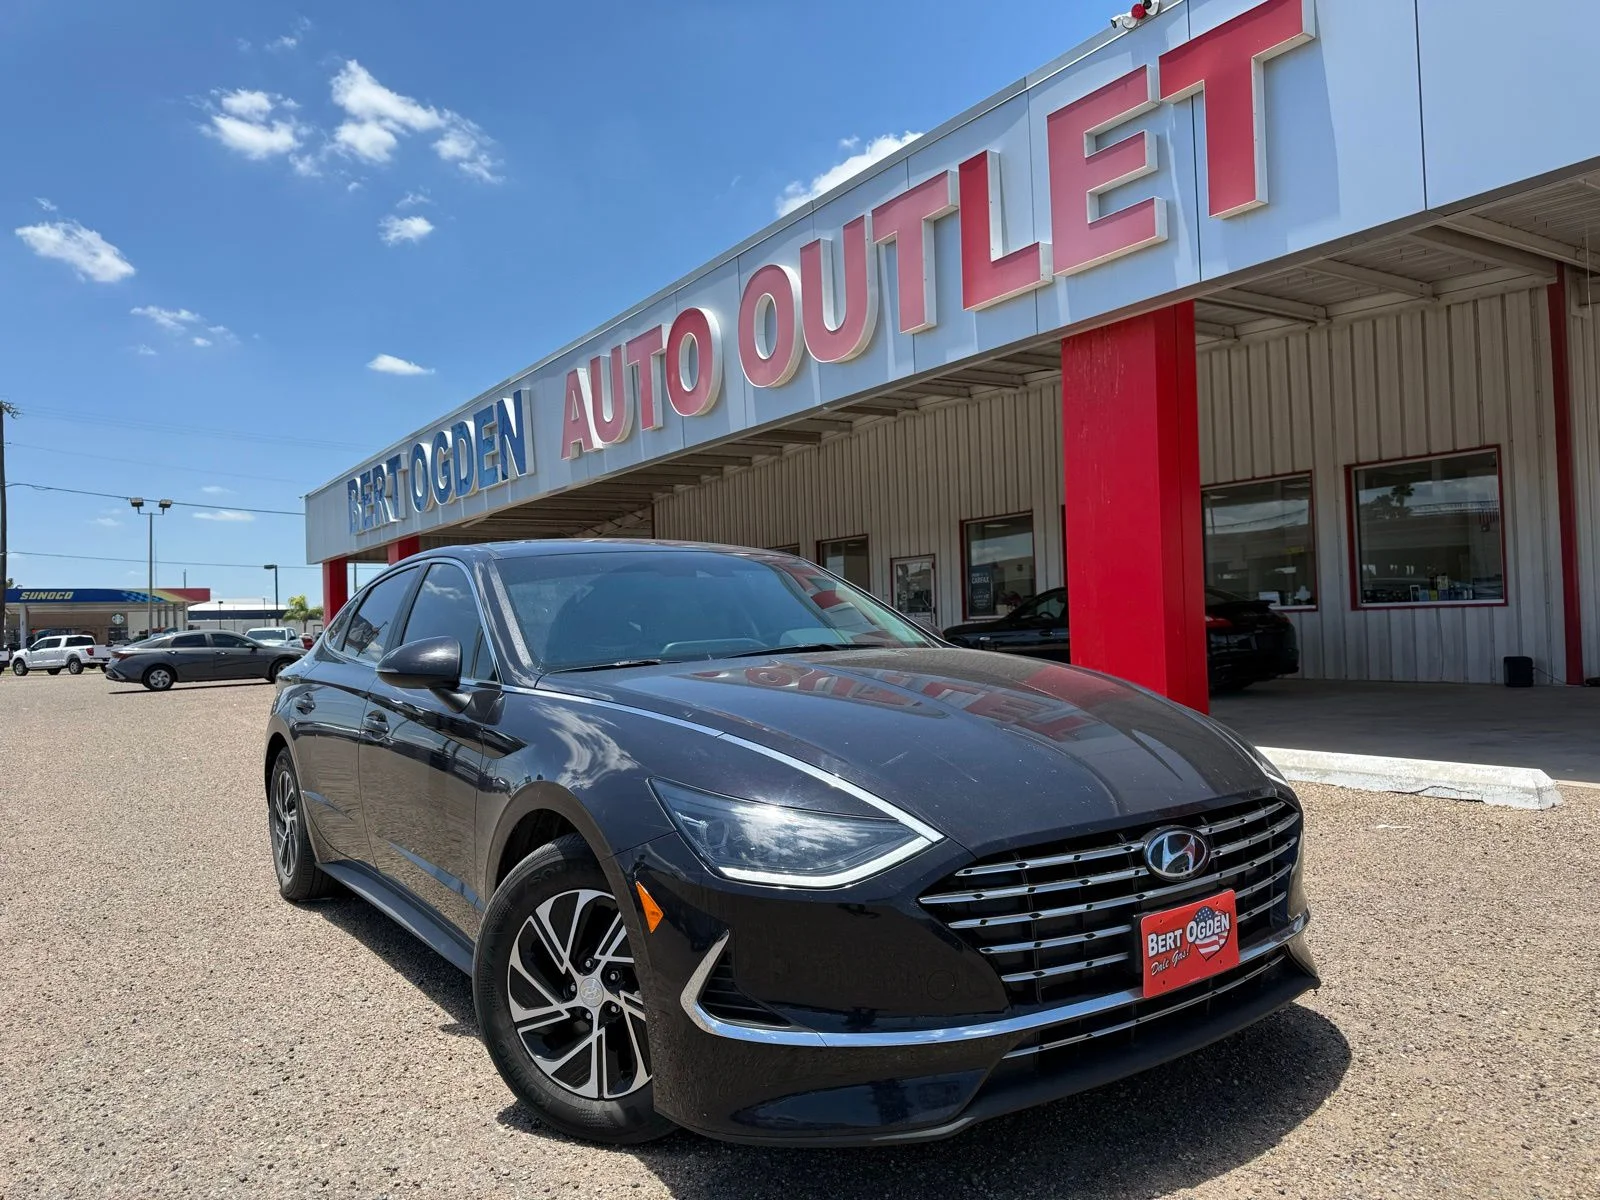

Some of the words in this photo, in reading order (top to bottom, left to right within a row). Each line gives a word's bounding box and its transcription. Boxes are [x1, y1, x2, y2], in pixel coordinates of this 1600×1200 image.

[348, 453, 406, 534] BERT
[410, 389, 534, 512] OGDEN
[561, 307, 722, 460] AUTO
[738, 0, 1316, 388] OUTLET
[20, 591, 74, 600] SUNOCO
[1148, 929, 1182, 957] BERT
[1186, 913, 1230, 943] OGDEN
[1150, 960, 1170, 976] Dale
[1171, 944, 1191, 968] Gas!
